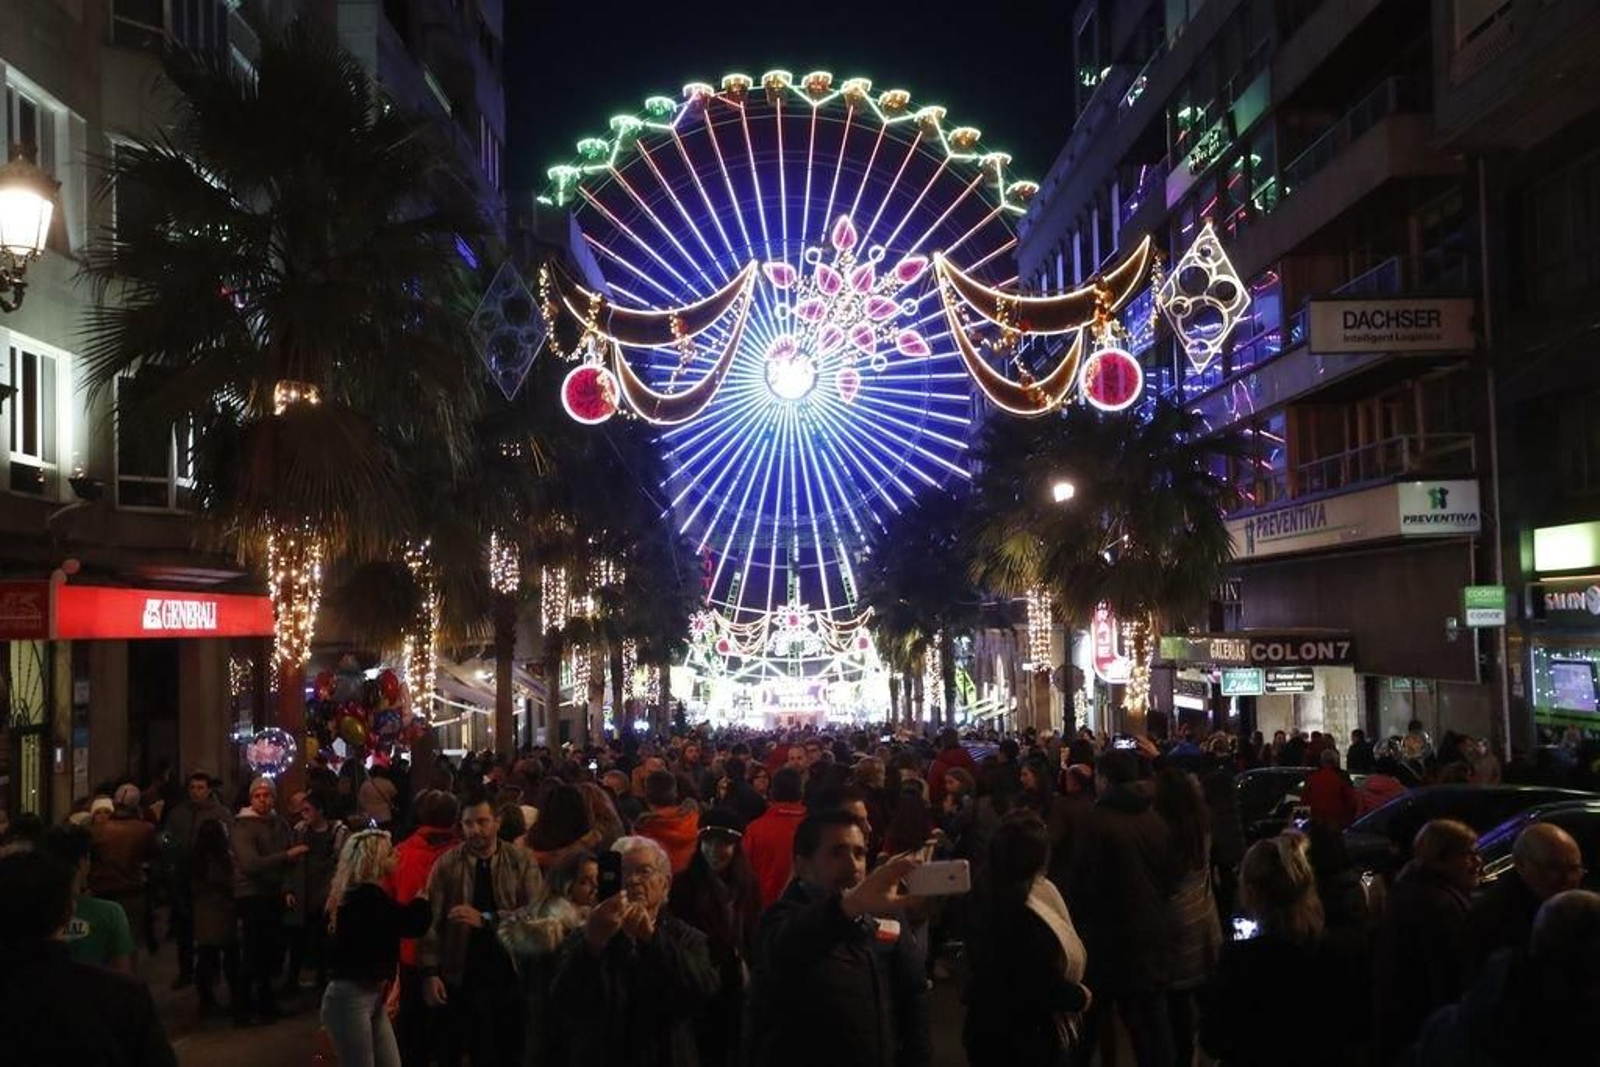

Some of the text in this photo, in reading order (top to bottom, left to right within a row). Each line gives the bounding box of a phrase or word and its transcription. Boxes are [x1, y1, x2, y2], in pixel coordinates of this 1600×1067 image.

[1342, 309, 1441, 330] DACHSER
[1343, 332, 1393, 344] Intelligent
[1256, 504, 1327, 538] PREVENTIVA
[1403, 511, 1477, 525] PREVENTIVA
[162, 600, 217, 630] GENERALI
